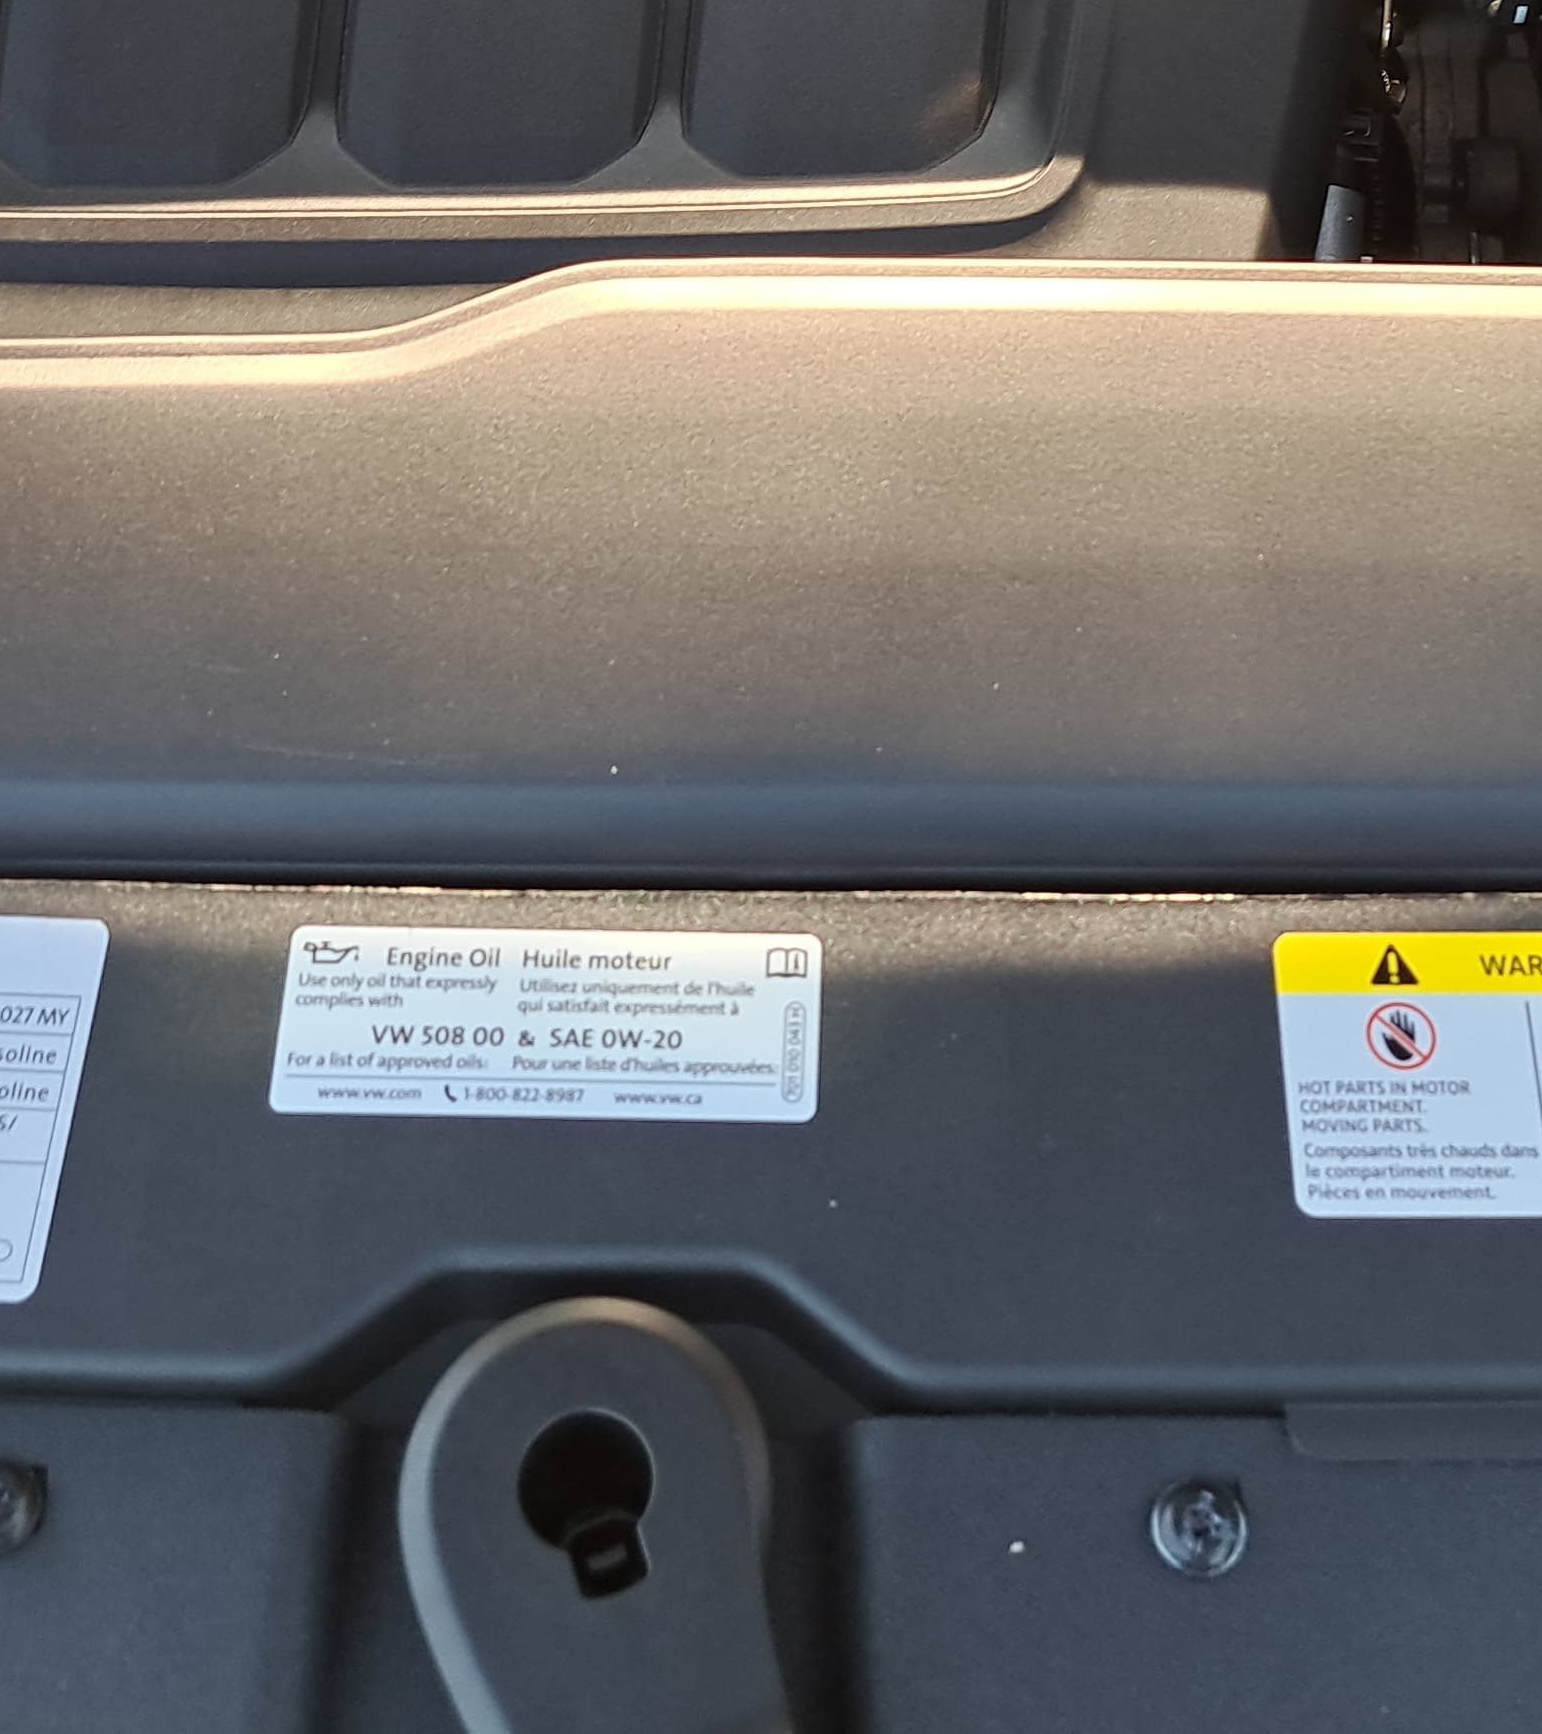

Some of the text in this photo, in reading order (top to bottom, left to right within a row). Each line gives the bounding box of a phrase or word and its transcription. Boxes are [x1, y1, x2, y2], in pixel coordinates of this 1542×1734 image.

[386, 947, 501, 971] Engine Oil
[522, 949, 672, 971] Huile moteur
[298, 972, 498, 995] Use only oil that expressly
[519, 978, 578, 994] Utilisez
[581, 980, 680, 997] uniquement
[683, 980, 704, 997] de
[294, 992, 404, 1011] complies with
[516, 997, 740, 1017] qui satisfait expressément à
[36, 1006, 69, 1026] MY
[372, 1025, 683, 1050] VW 508 00 & SAE 0W-20
[286, 1051, 313, 1067] For
[315, 1055, 326, 1067] a
[329, 1051, 354, 1068] list
[356, 1051, 376, 1069] of
[376, 1053, 453, 1073] approved
[511, 1054, 549, 1071] Pour
[551, 1059, 582, 1072] une
[584, 1055, 617, 1073] liste
[317, 1088, 422, 1100] www.vw.com
[464, 1086, 585, 1103] 1-800-822-8987
[1297, 1080, 1471, 1096] HOT PARTS IN MOTOR
[614, 1093, 703, 1106] www.vw.ca
[1301, 1118, 1369, 1134] MOVING
[1303, 1142, 1540, 1161] Composants très chauds dans
[1304, 1162, 1516, 1182] le compartiment moteur.
[1307, 1183, 1361, 1200] Pièces
[1364, 1186, 1387, 1200] en
